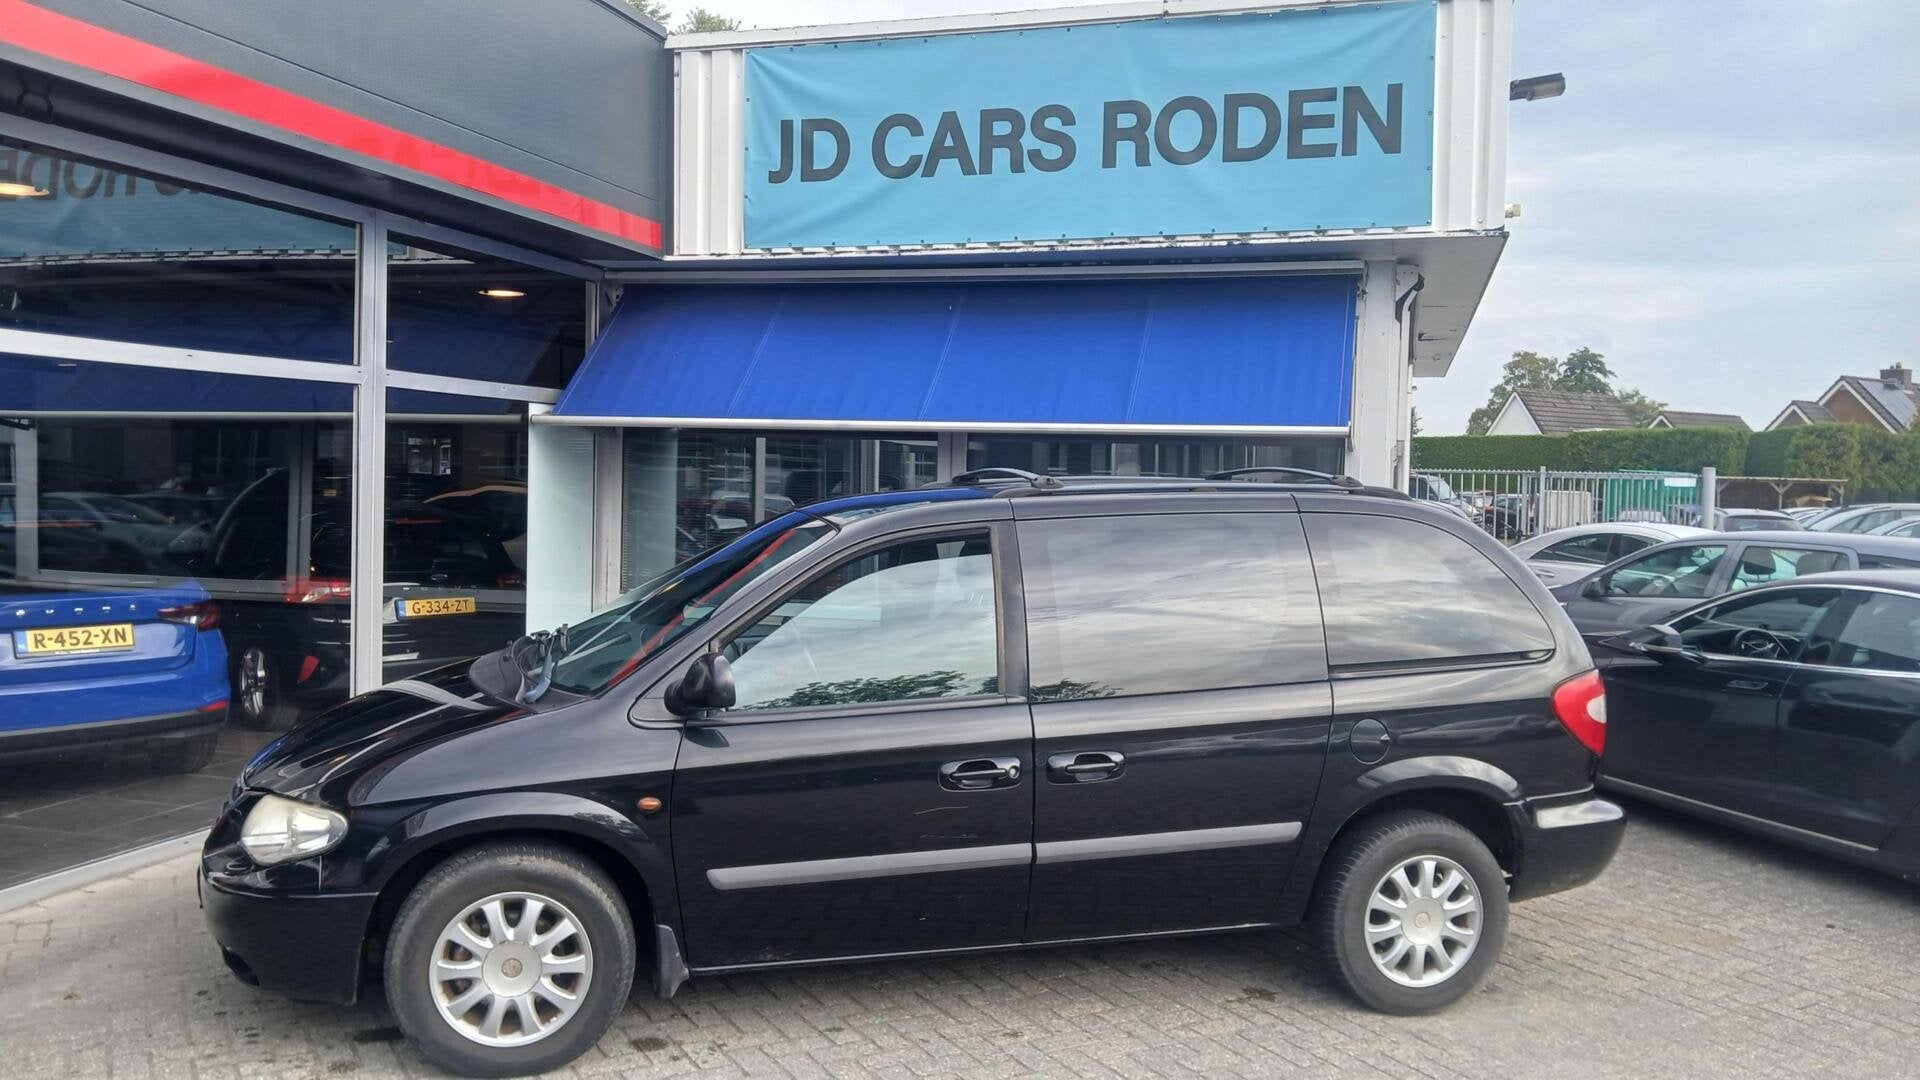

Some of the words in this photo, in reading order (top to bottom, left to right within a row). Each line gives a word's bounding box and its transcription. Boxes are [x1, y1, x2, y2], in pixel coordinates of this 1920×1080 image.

[768, 118, 851, 184] JD
[871, 104, 1077, 180] CARS
[1101, 83, 1403, 169] RODEN
[411, 599, 470, 615] G-334-ZT
[33, 626, 128, 649] R-452-XN
